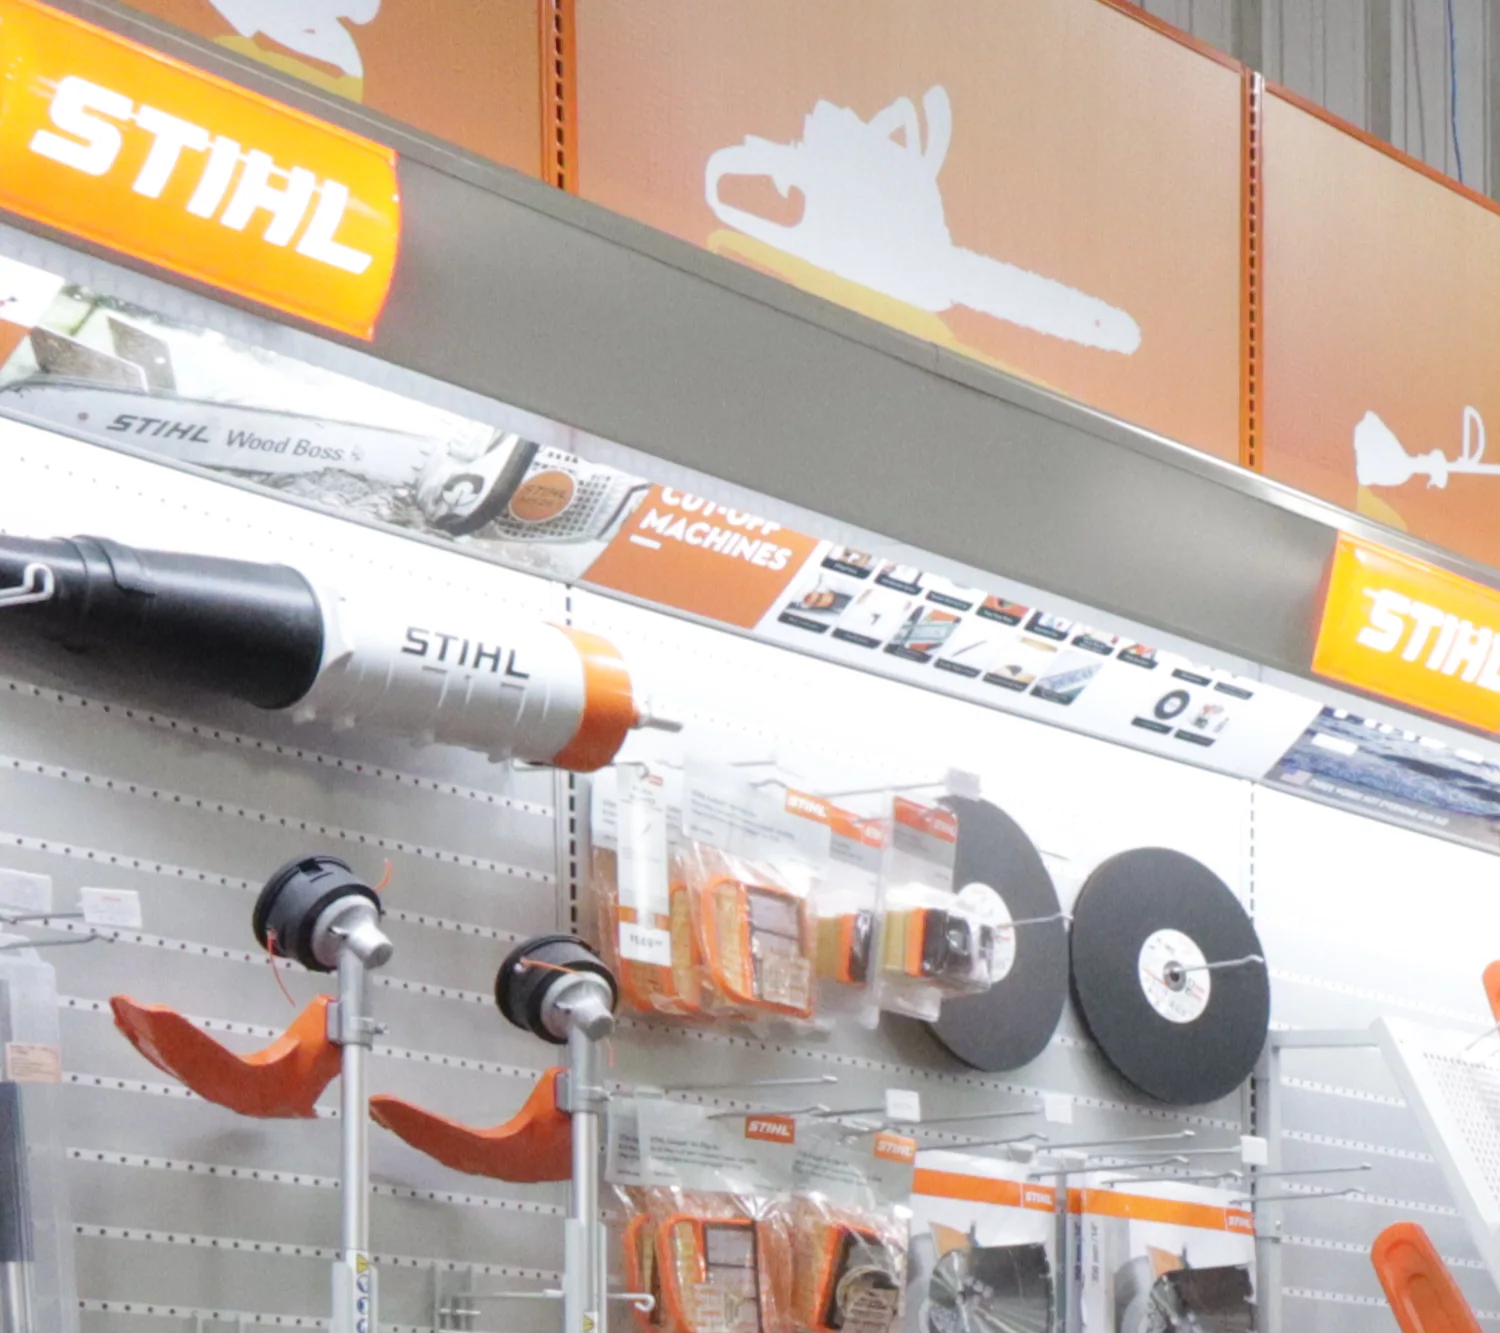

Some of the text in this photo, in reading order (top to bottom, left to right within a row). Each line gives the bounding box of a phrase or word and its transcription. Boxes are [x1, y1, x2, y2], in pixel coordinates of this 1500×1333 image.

[28, 75, 373, 275] STIHL
[106, 414, 345, 462] STIHL Wood Boss
[639, 508, 793, 571] MACHINES
[400, 627, 531, 682] STIHL
[748, 1120, 791, 1137] STIHL
[876, 1139, 914, 1157] STIHL
